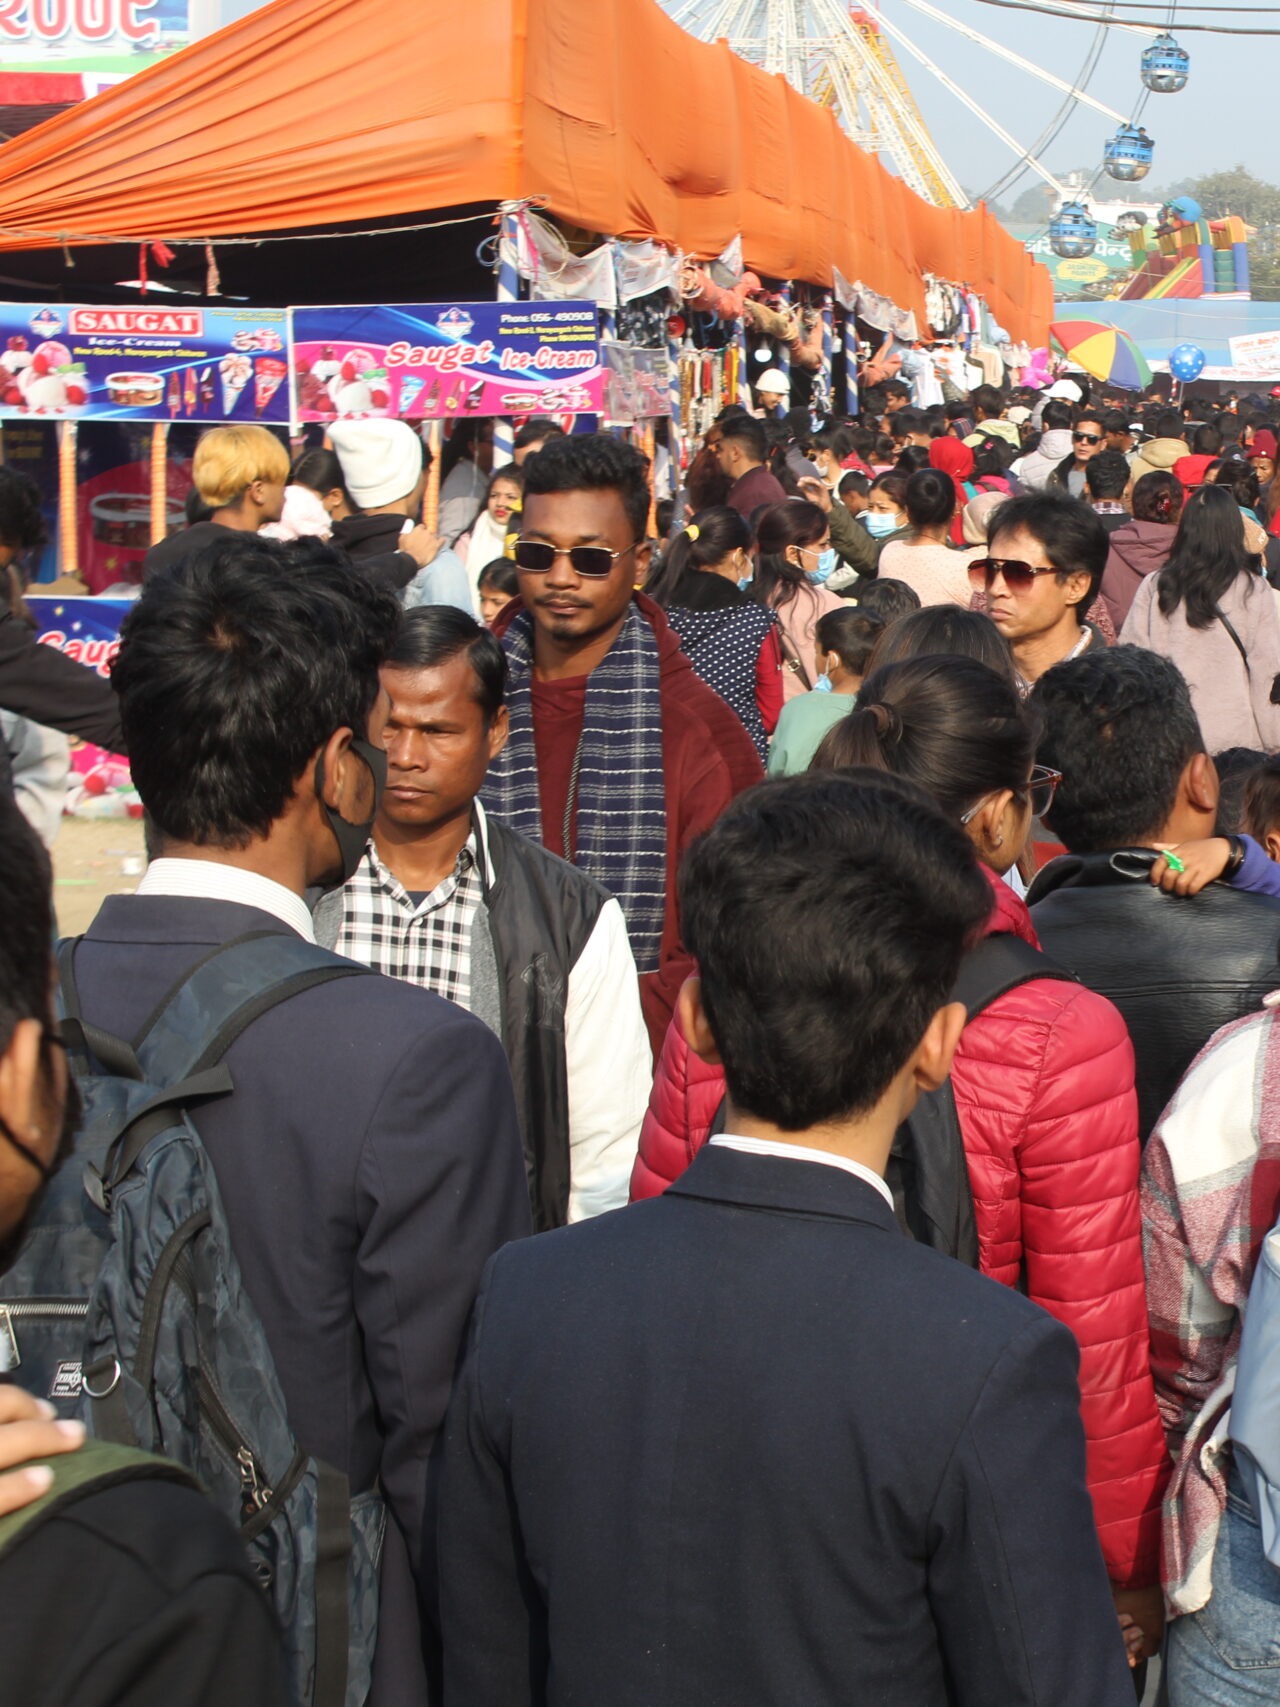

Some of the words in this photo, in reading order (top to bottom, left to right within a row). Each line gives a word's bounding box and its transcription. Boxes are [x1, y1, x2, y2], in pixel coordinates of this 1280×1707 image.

[77, 312, 199, 332] SAUGAT
[88, 337, 182, 347] Ice-Cream
[386, 342, 493, 371] Saugat
[501, 347, 596, 369] Ice-Cream
